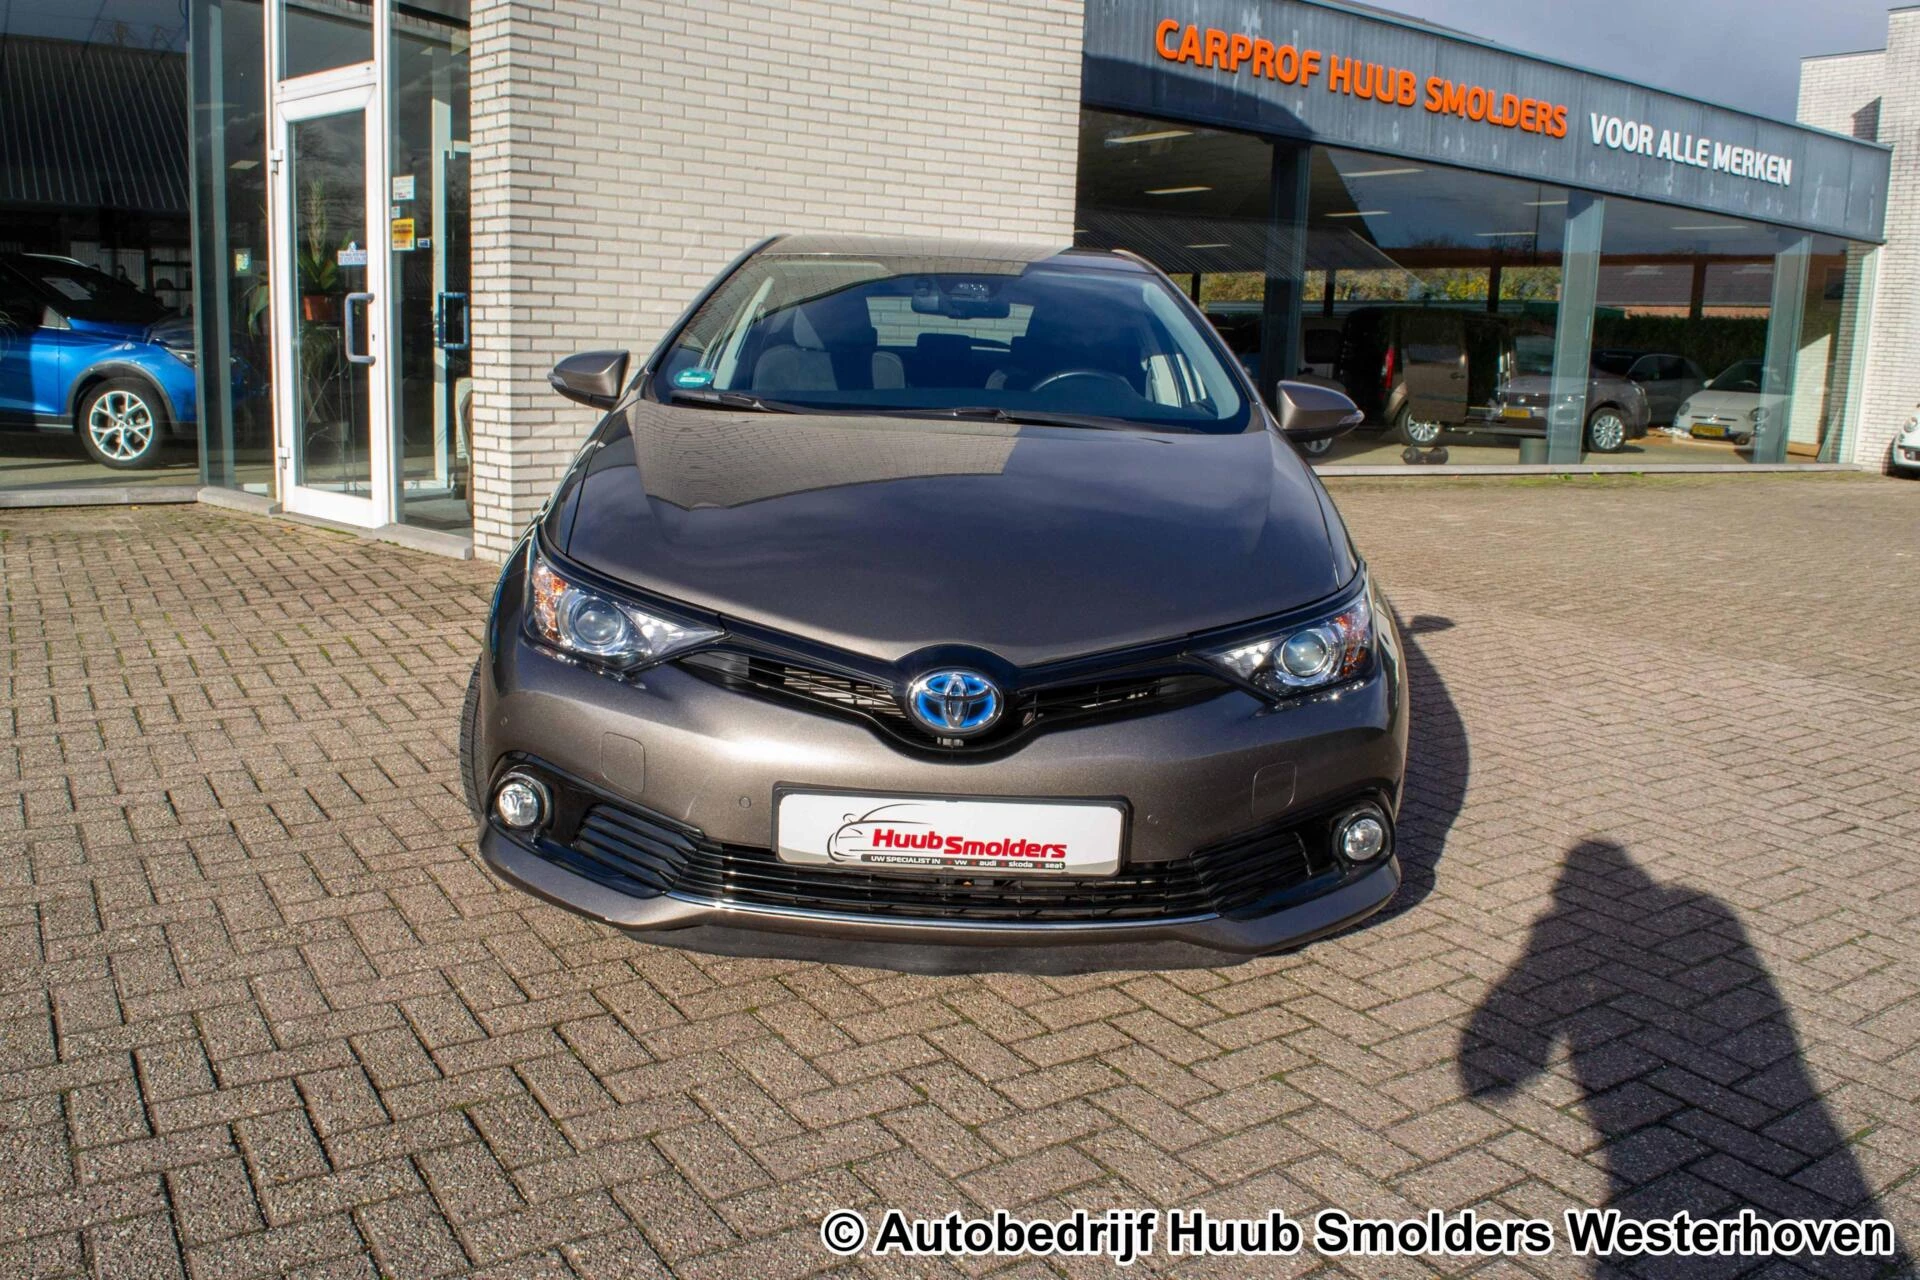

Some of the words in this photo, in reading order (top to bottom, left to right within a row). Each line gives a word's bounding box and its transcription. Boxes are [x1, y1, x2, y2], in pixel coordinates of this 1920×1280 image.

[1155, 18, 1321, 87] CARPROF
[1329, 54, 1417, 107] HUUB
[1424, 76, 1568, 139] SMOLDERS
[1590, 112, 1654, 156] VOOR
[1656, 129, 1709, 168] ALLE
[1712, 142, 1792, 186] MERKEN
[886, 855, 930, 864] SPECIALIST
[931, 857, 941, 865] IN
[979, 859, 997, 867] audi
[1008, 860, 1033, 868] skoda
[1044, 861, 1064, 869] seat
